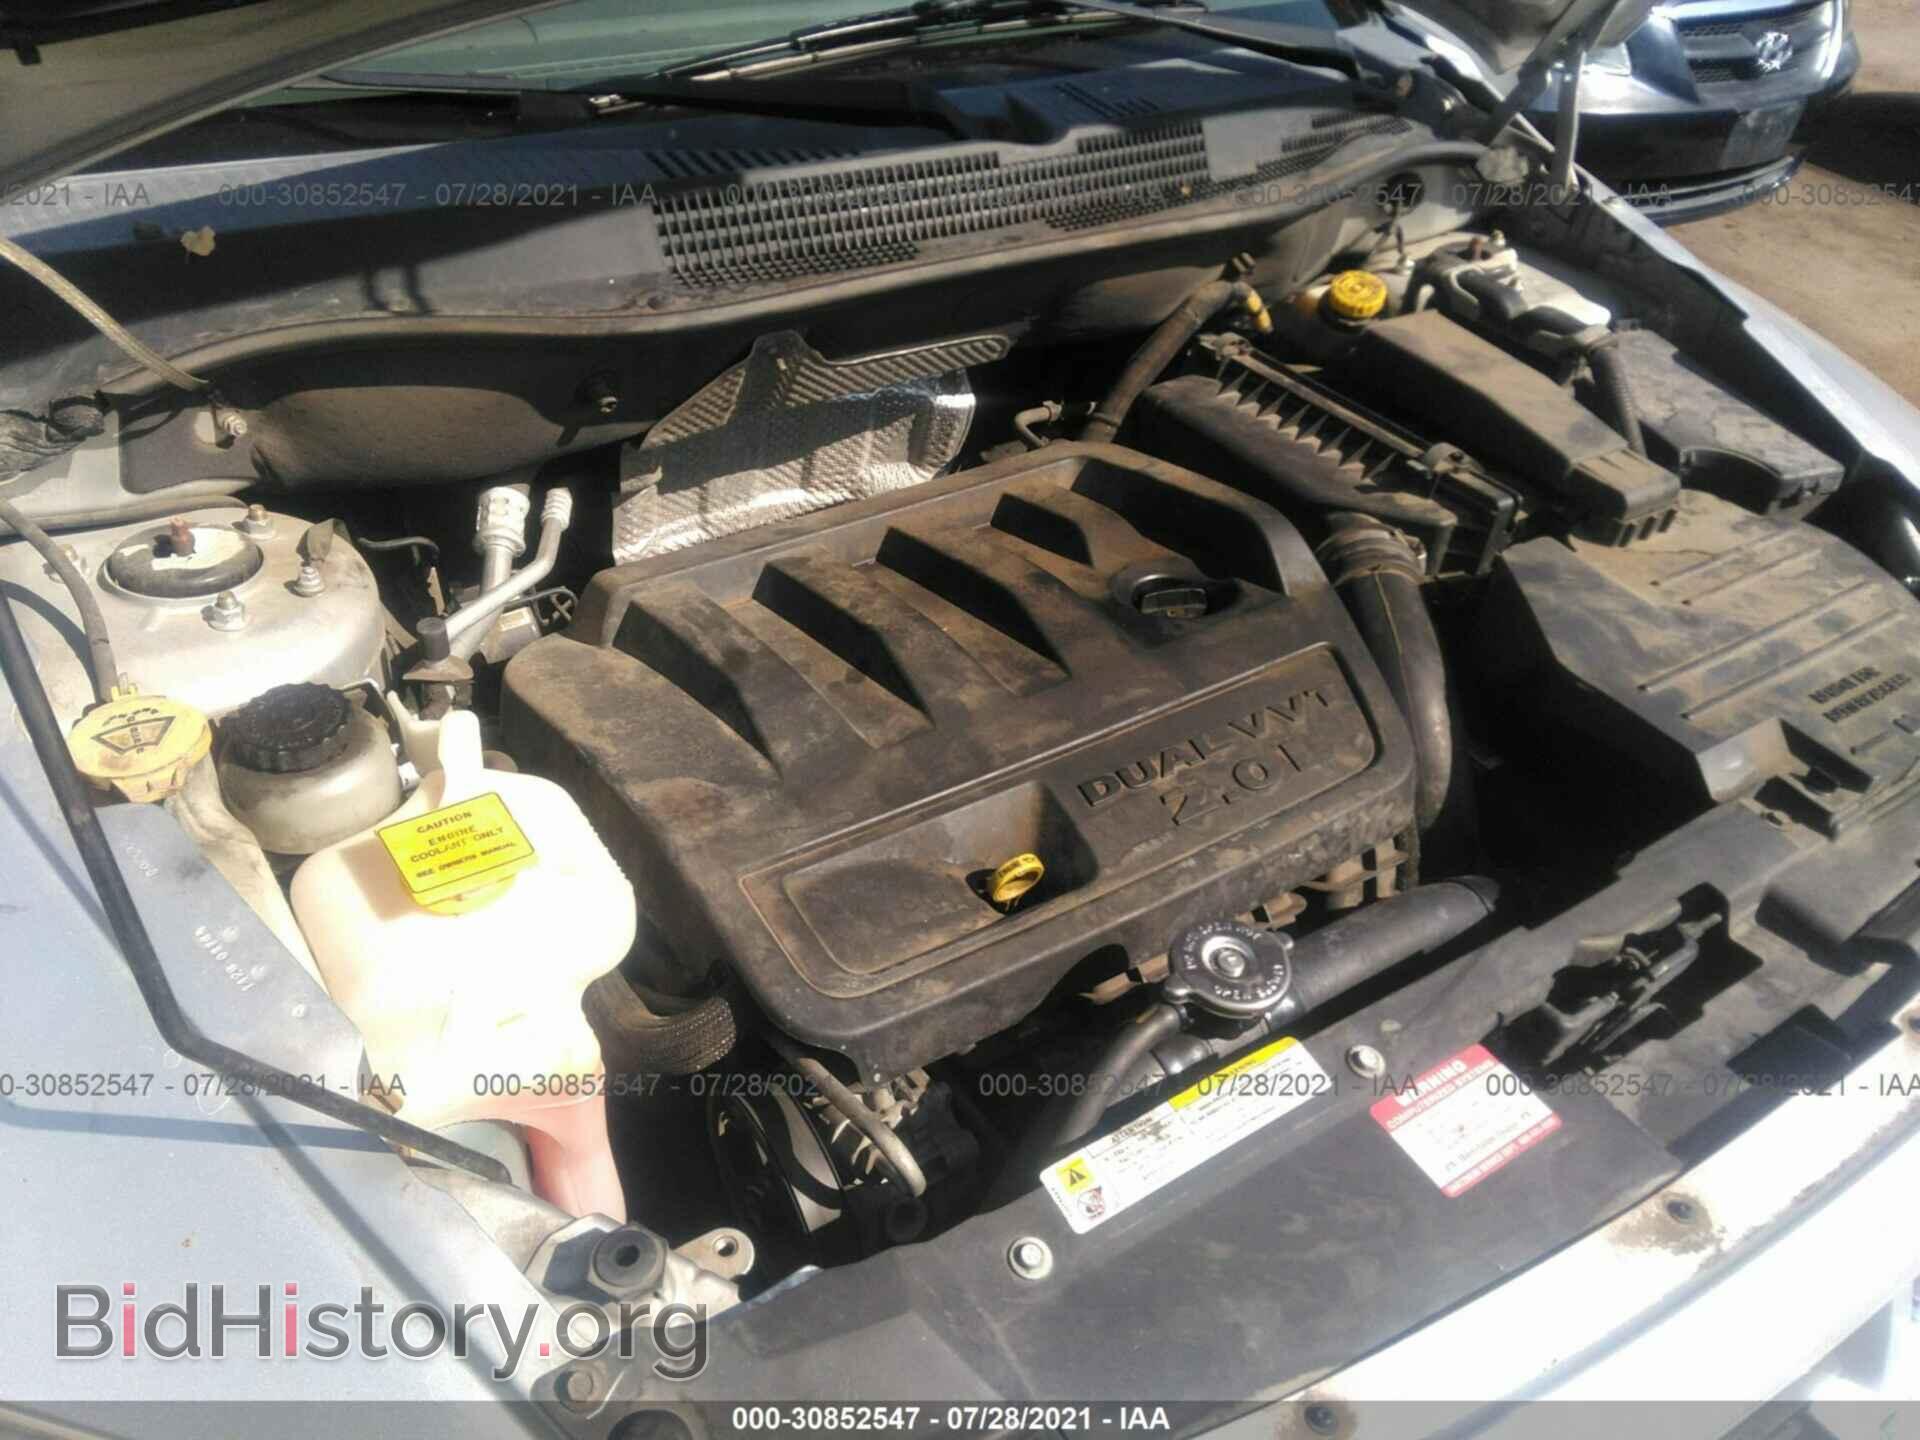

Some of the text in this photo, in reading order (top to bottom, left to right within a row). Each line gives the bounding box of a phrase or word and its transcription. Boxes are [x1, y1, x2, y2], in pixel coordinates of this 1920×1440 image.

[416, 811, 473, 834] CAUTION
[410, 826, 504, 863] COOLANT ONLY
[428, 825, 477, 846] ENGINE
